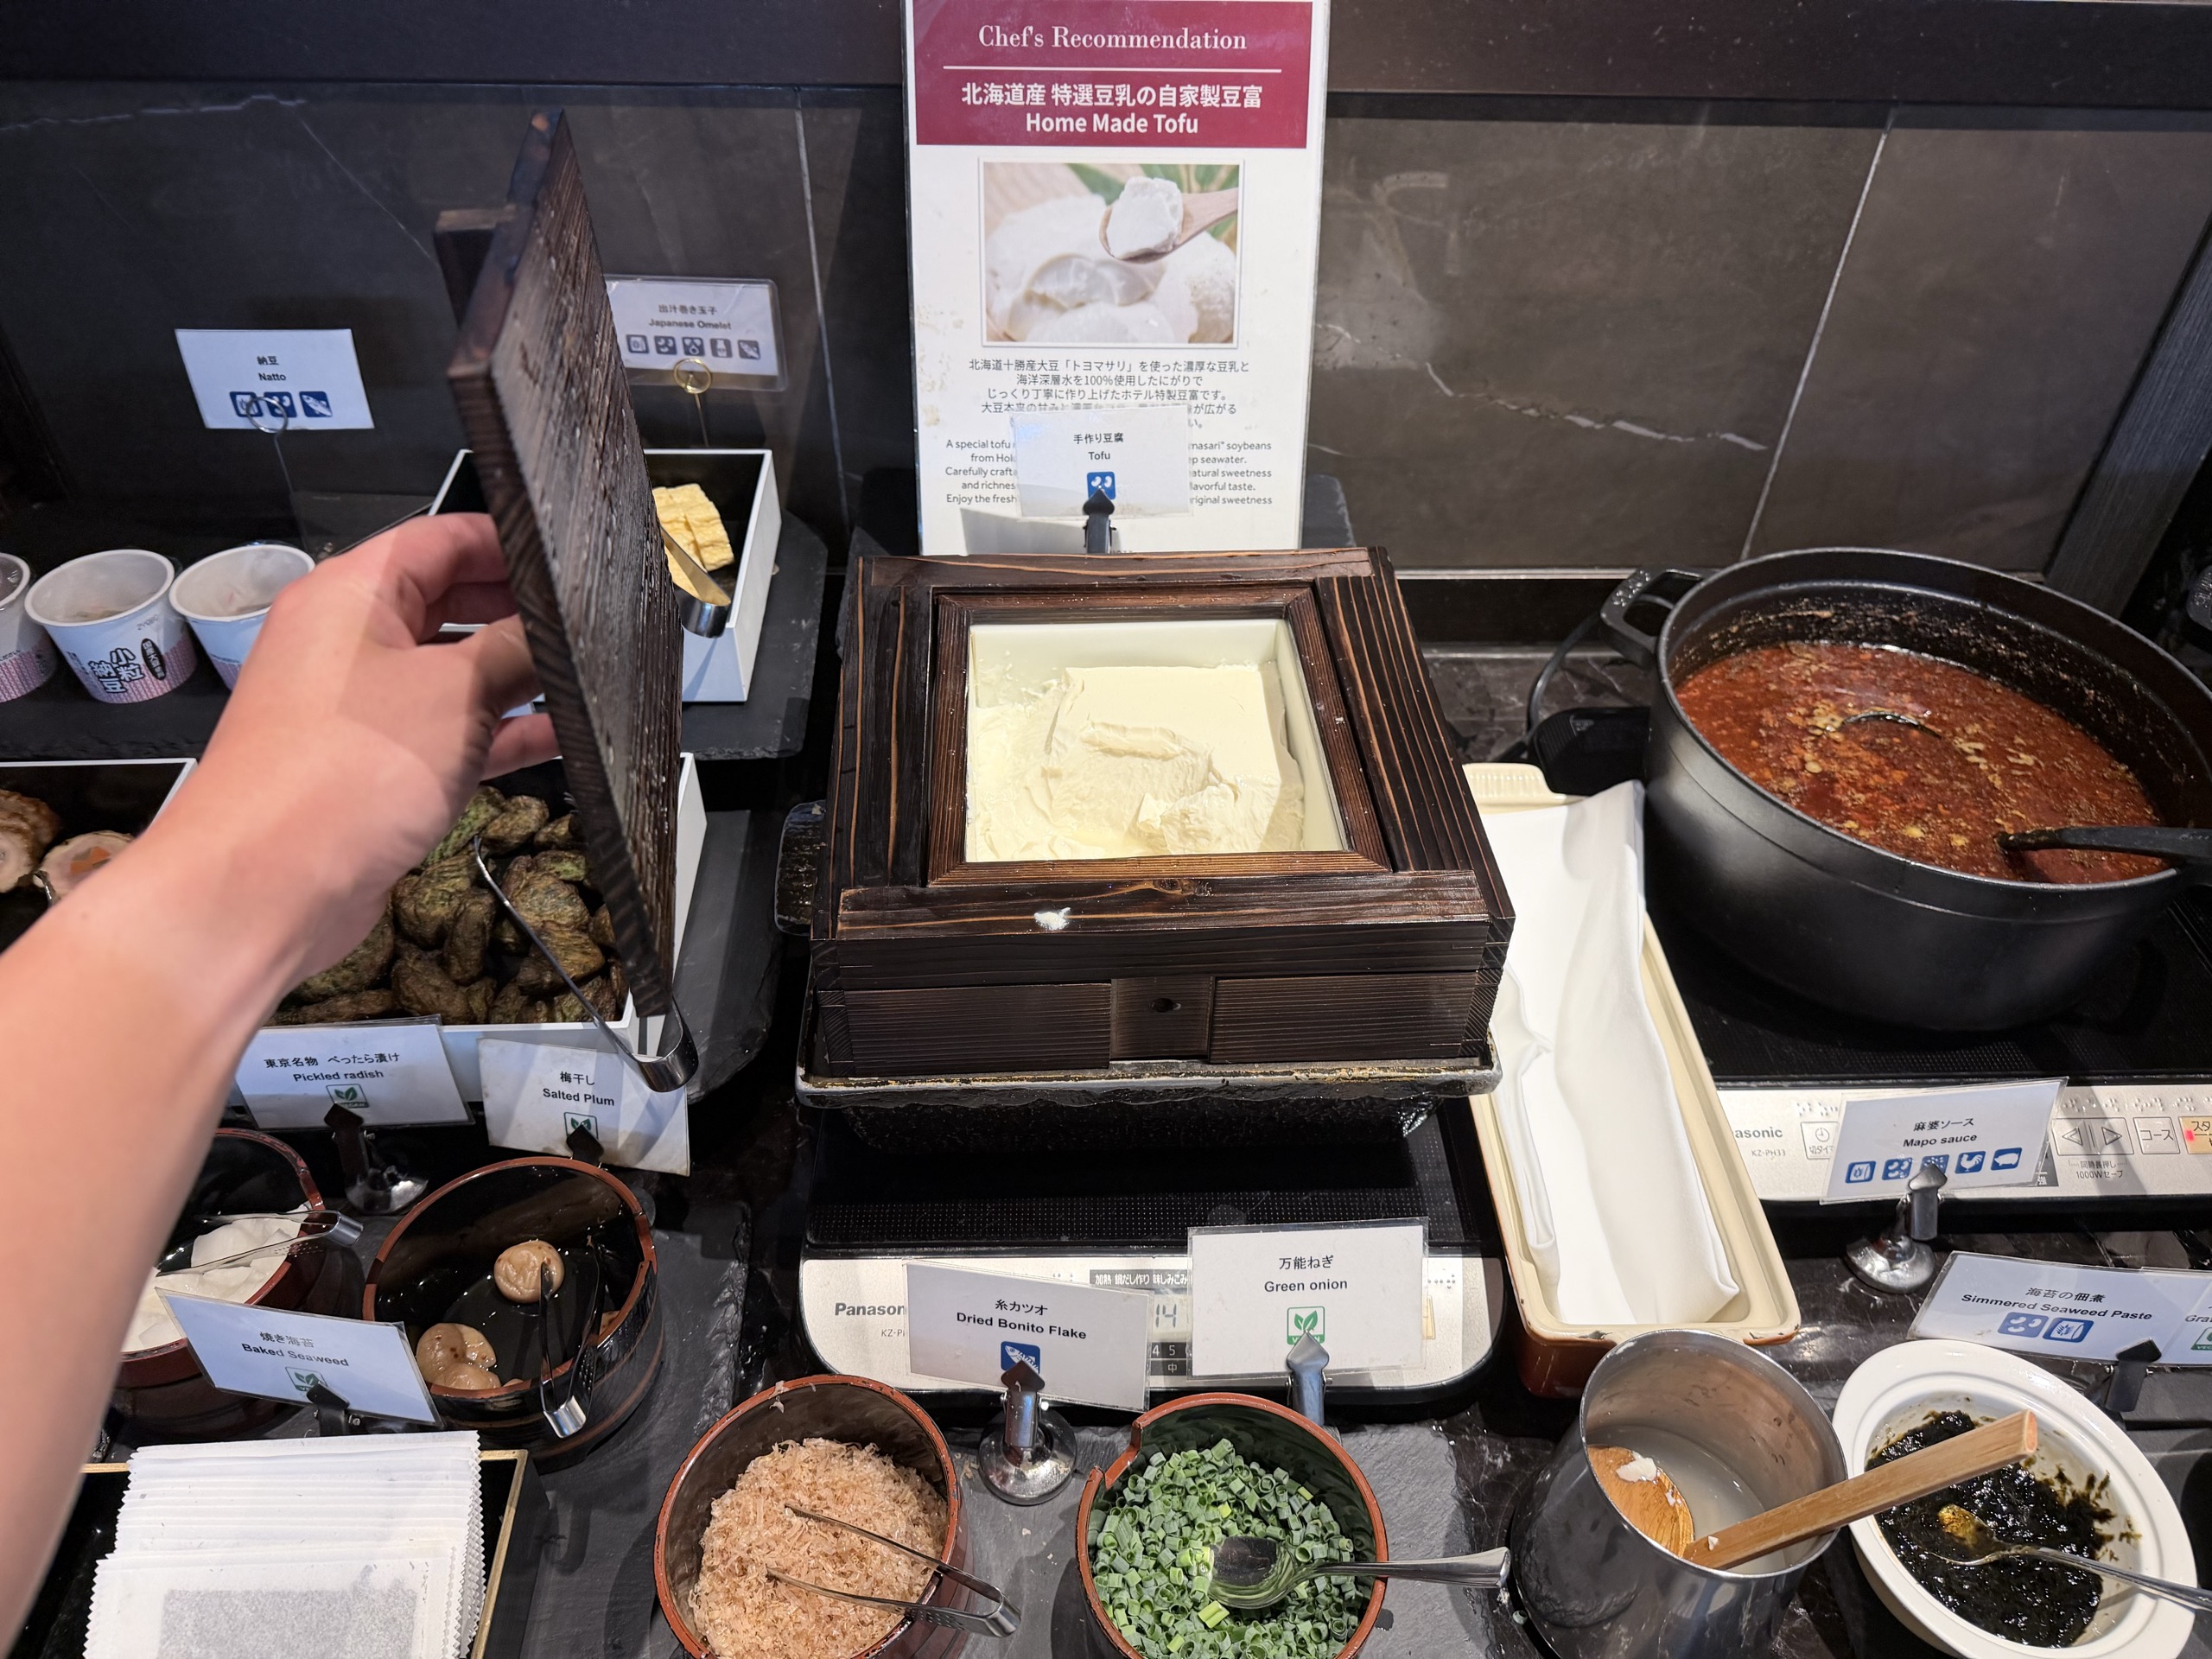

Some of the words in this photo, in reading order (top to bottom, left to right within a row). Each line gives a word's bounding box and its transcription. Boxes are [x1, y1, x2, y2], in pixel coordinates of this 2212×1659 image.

[978, 25, 1044, 48] Chef's
[1052, 26, 1247, 49] Recommendation
[961, 83, 1046, 106] 北海道産
[1051, 84, 1262, 108] 特選豆乳の自家製豆富
[1026, 113, 1086, 133] Home
[1092, 114, 1148, 134] Made
[1154, 113, 1198, 134] Tofu
[649, 319, 695, 329] Japanese
[697, 321, 732, 330] Omelet
[257, 356, 279, 365] 納豆
[1073, 432, 1123, 444] 手作り豆腐
[946, 440, 953, 448] A
[956, 440, 988, 451] special
[990, 440, 1011, 448] tofu
[1226, 442, 1272, 452] soybeans
[970, 454, 994, 462] from
[1088, 450, 1110, 460] Tofu
[945, 467, 988, 478] Carefully
[1221, 469, 1272, 478] sweetness
[962, 481, 980, 490] and
[982, 481, 1015, 490] richnes
[1189, 482, 1226, 491] lavorful
[946, 494, 973, 505] Enjoy
[975, 494, 991, 503] the
[1190, 496, 1220, 506] riginal
[1222, 496, 1272, 505] sweetness
[264, 1056, 319, 1068] 東京名物
[327, 1052, 400, 1065] べったら漬け
[293, 1071, 340, 1082] Pickled
[344, 1070, 384, 1080] radish
[560, 1071, 595, 1086] 梅干し
[543, 1088, 580, 1102] Salted
[584, 1093, 615, 1106] Plum
[1913, 1117, 1974, 1132] 麻婆ソース
[1735, 1126, 1783, 1138] asonic
[2141, 1129, 2174, 1141] コース
[1903, 1138, 1937, 1147] Mapo
[1940, 1134, 1977, 1144] sauce
[1278, 1254, 1334, 1271] 万能ねぎ
[1264, 1279, 1306, 1293] Green
[1309, 1278, 1348, 1292] onion
[2025, 1287, 2106, 1303] 海苔の佃煮
[995, 1298, 1048, 1316] 糸カツオ
[1961, 1294, 2037, 1310] Simmered
[2040, 1302, 2107, 1318] Seaweed
[2111, 1309, 2153, 1320] Paste
[956, 1312, 994, 1327] Dried
[997, 1318, 1045, 1335] Bonito
[1048, 1325, 1087, 1340] Flake
[260, 1332, 314, 1348] 焼き海苔
[241, 1343, 284, 1357] Baked
[287, 1350, 349, 1366] Seaweed
[1152, 1344, 1160, 1357] 4
[1169, 1344, 1176, 1356] 5
[1167, 1363, 1178, 1373] 中
